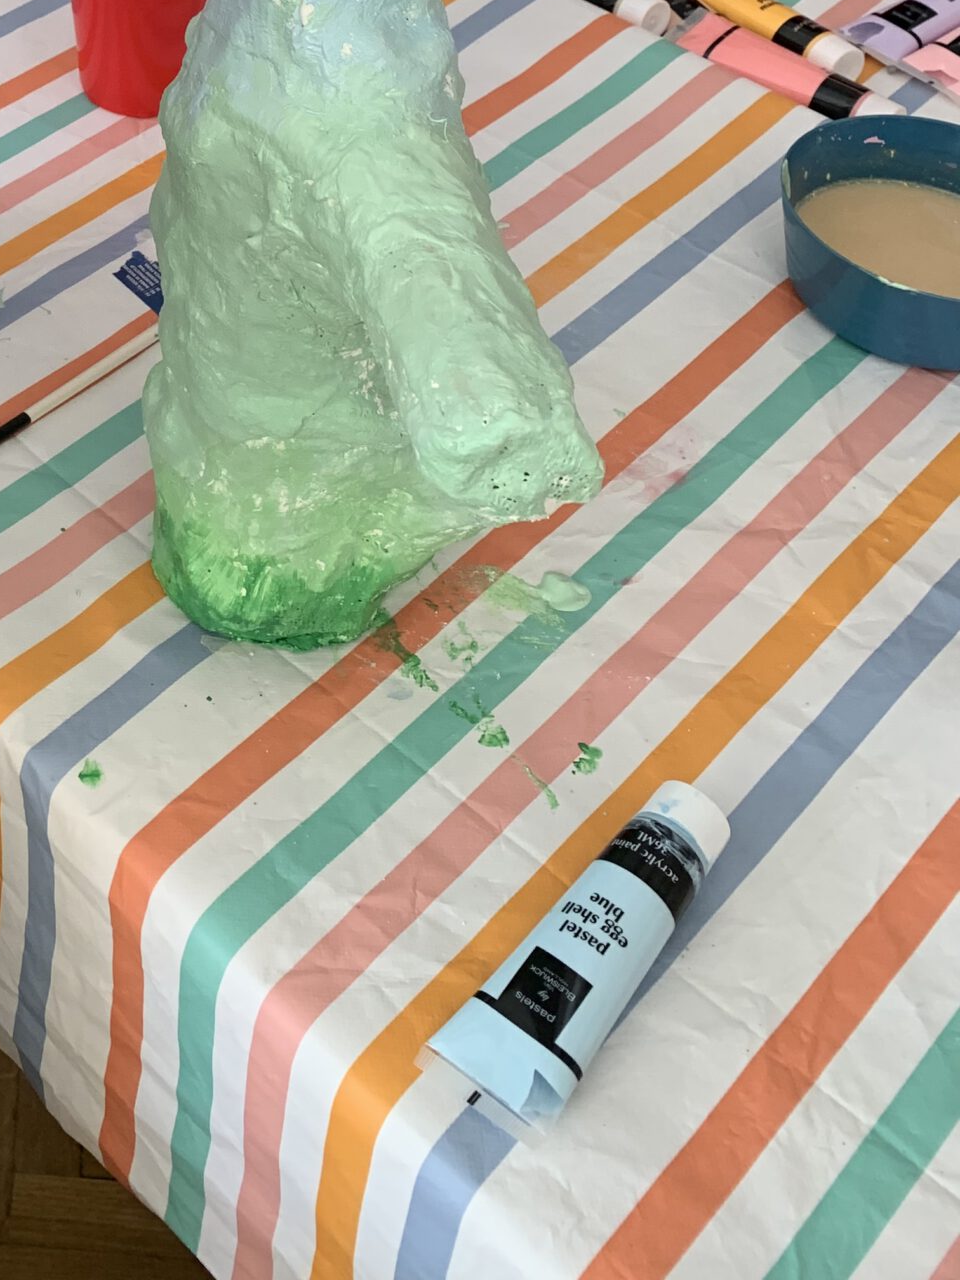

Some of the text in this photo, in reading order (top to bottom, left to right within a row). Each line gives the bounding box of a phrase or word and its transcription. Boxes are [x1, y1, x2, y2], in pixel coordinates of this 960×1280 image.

[640, 848, 679, 884] acrylic
[561, 900, 629, 948] egg shell
[589, 891, 625, 923] blue
[558, 919, 611, 956] pastel
[515, 990, 557, 1023] pastels
[537, 989, 550, 1002] by
